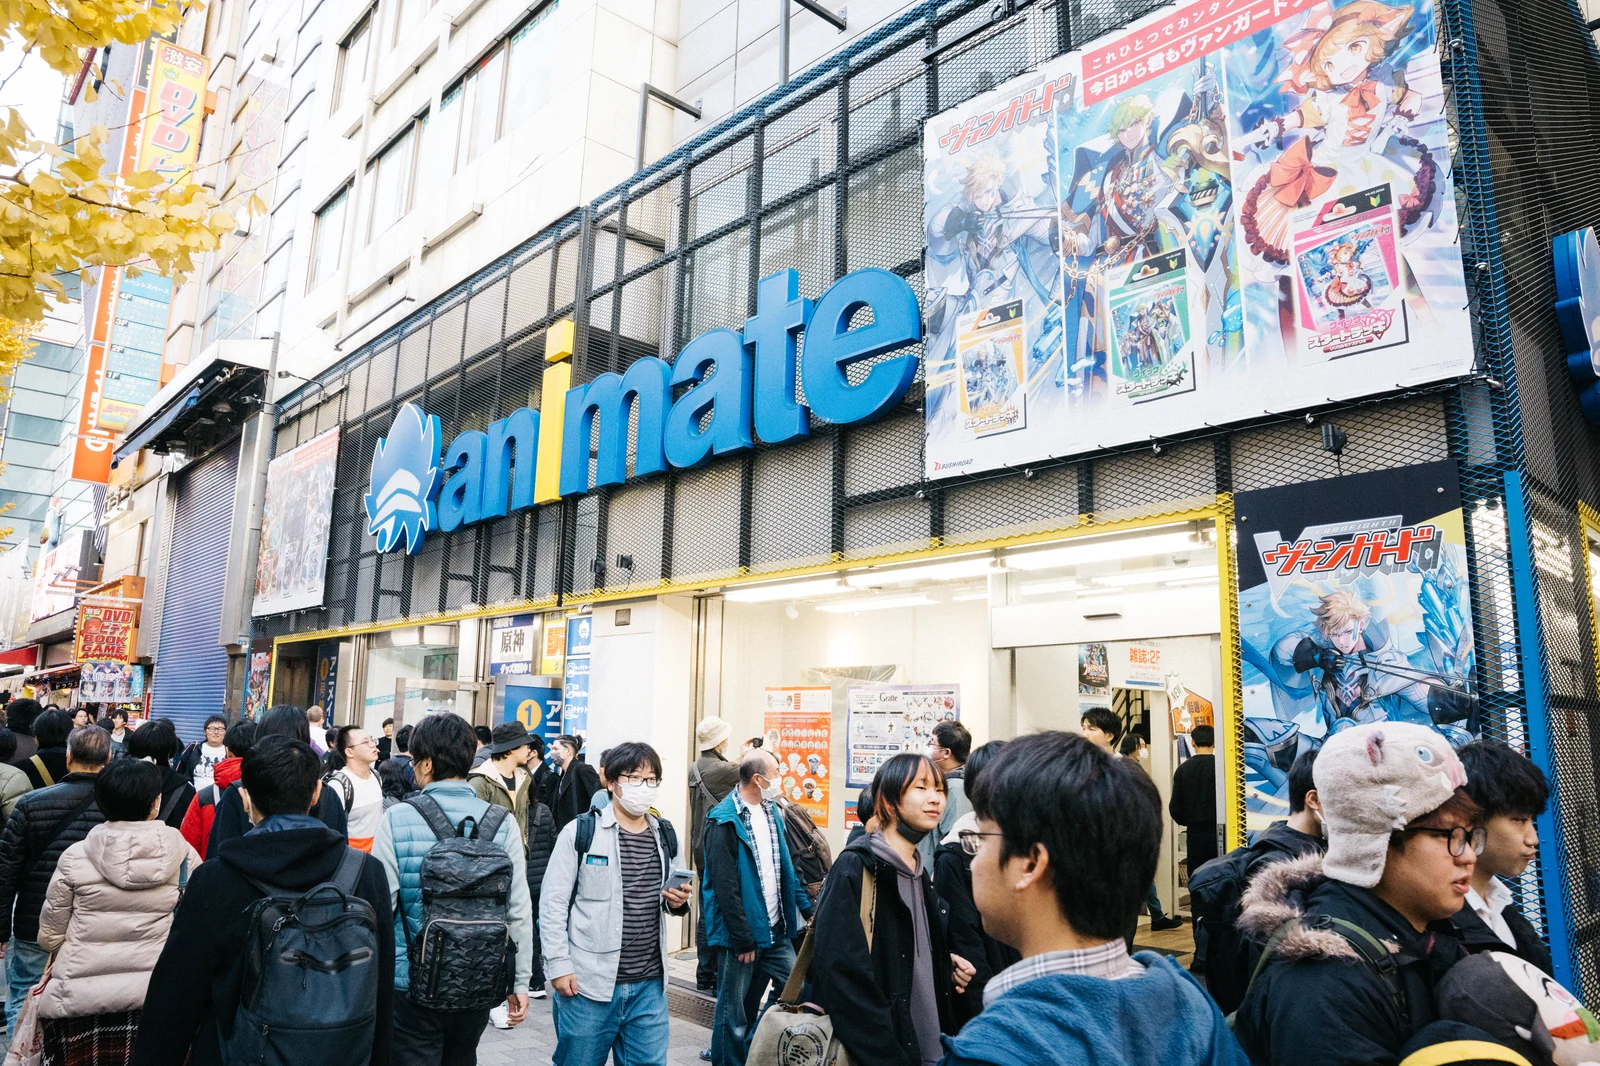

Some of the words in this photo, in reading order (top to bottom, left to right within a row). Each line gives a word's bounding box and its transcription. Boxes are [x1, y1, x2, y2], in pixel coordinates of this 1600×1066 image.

[939, 73, 1071, 155] ヴァンガード
[119, 292, 133, 300] 4F
[115, 318, 129, 327] 3F
[111, 345, 125, 353] 2F
[107, 371, 120, 380] 1F
[437, 267, 922, 532] animate
[1263, 525, 1435, 577] ヴァンガード
[102, 609, 132, 624] DVD
[83, 634, 127, 646] BOOK
[500, 628, 526, 654] 原神
[81, 644, 127, 656] GAME
[879, 692, 899, 703] Gratte
[525, 704, 532, 727] 1
